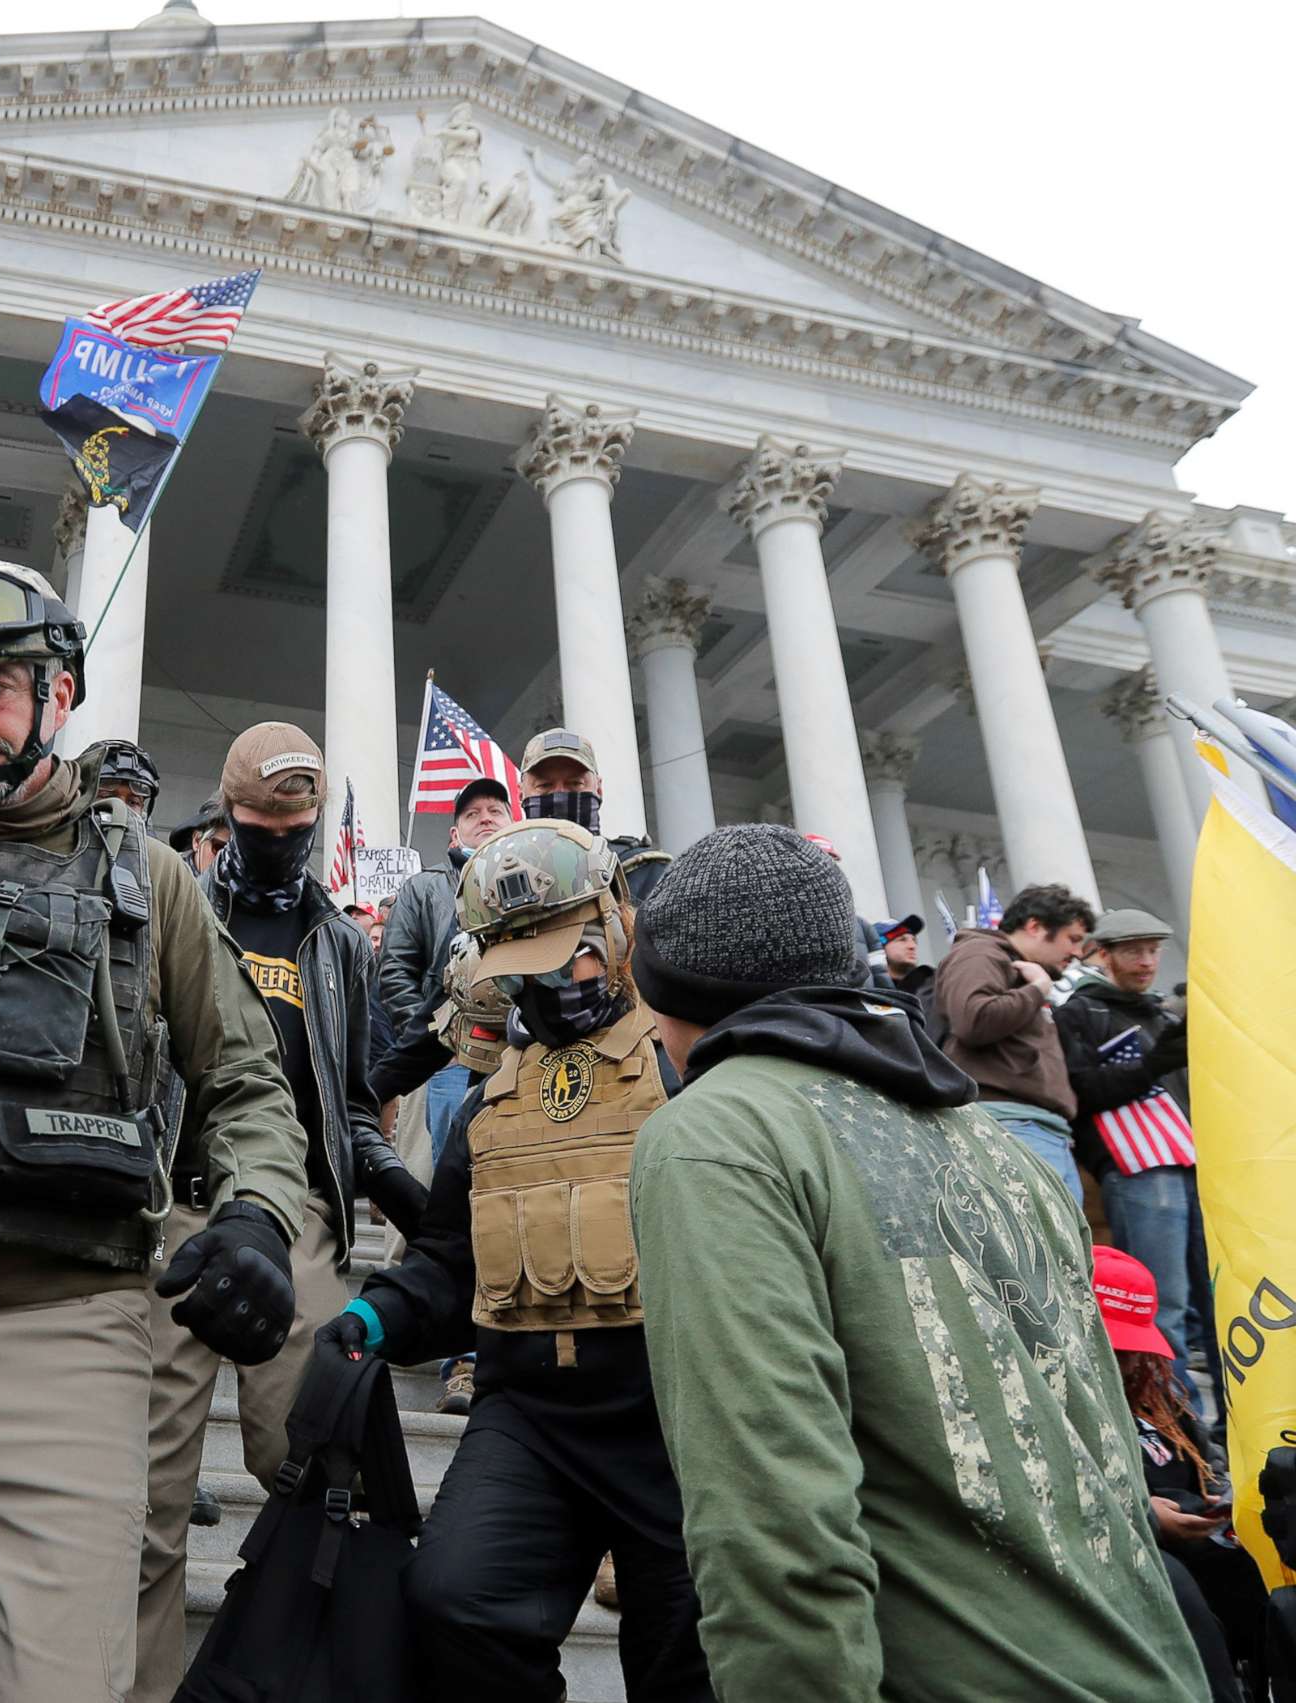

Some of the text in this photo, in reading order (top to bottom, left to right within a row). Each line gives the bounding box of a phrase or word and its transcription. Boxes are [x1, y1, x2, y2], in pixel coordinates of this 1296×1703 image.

[357, 848, 394, 861] EXPOSE
[359, 875, 395, 890] DRAIN
[45, 1113, 127, 1141] TRAPPER
[997, 1279, 1044, 1326] R
